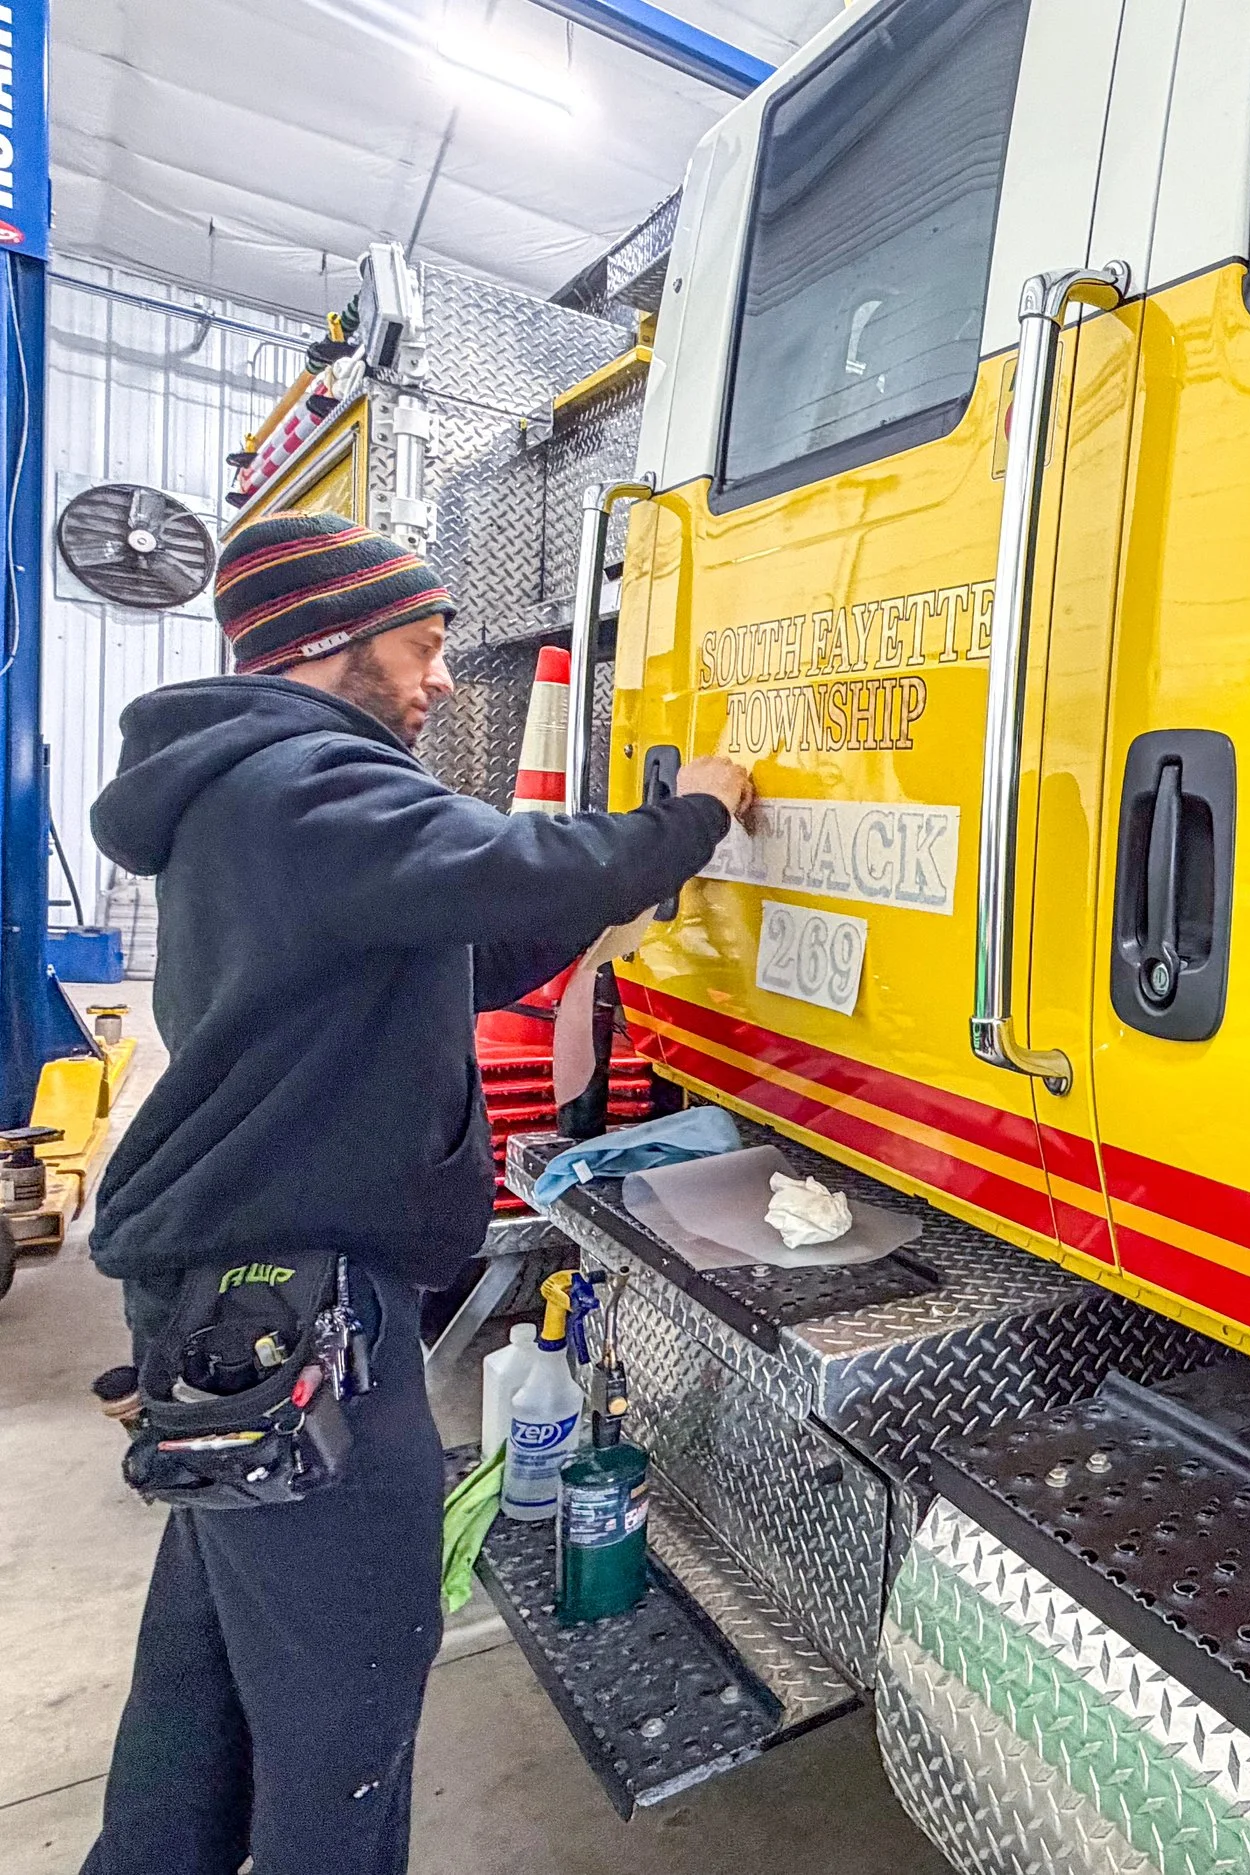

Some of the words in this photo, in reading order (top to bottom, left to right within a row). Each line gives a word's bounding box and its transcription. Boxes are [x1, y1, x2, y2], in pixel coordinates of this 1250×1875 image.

[699, 613, 807, 690] SOUTH
[803, 578, 996, 678] FAYETTE
[726, 676, 928, 754] TOWNSHIP
[762, 909, 863, 1005] 269
[218, 1263, 296, 1293] AWP
